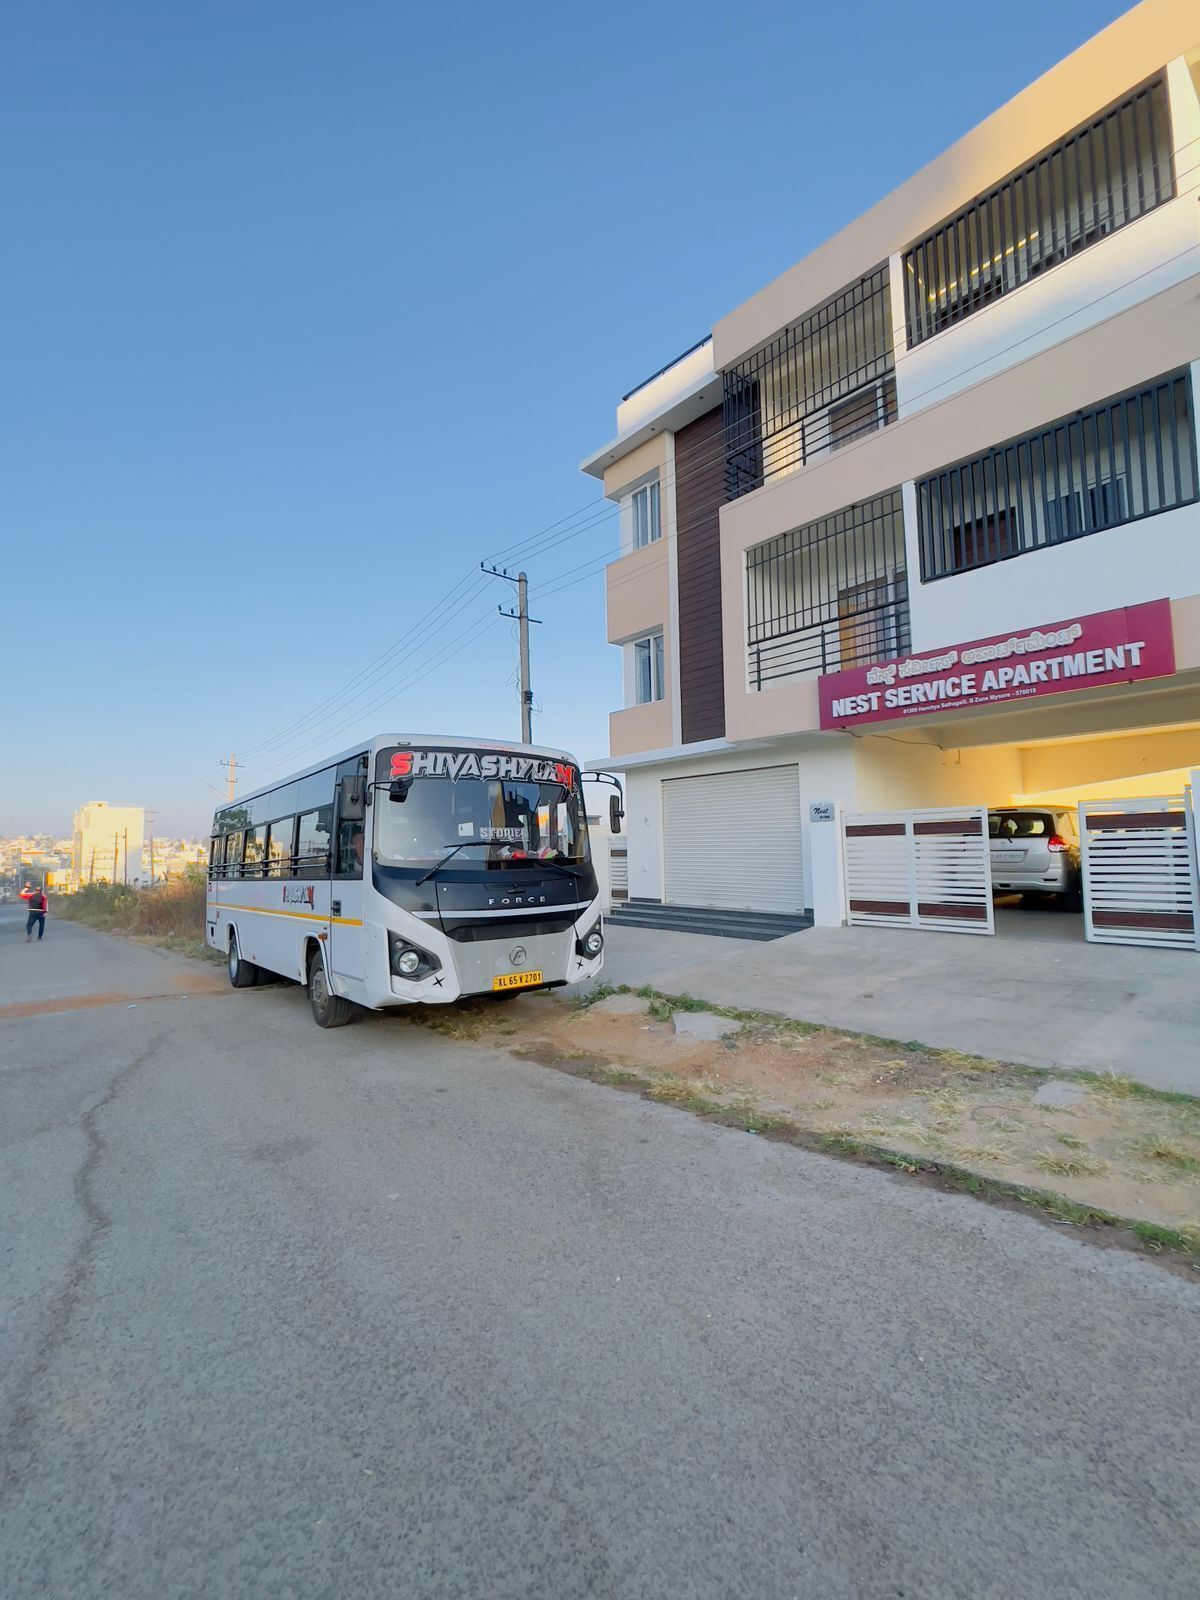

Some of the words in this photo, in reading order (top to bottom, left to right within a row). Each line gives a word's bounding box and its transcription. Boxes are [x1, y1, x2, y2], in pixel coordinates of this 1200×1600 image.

[832, 691, 881, 717] NEST
[885, 674, 977, 708] SERVICE
[981, 642, 1145, 692] APARTMENT
[488, 896, 546, 905] FORCE
[508, 975, 518, 985] 65
[524, 972, 541, 983] 2701
